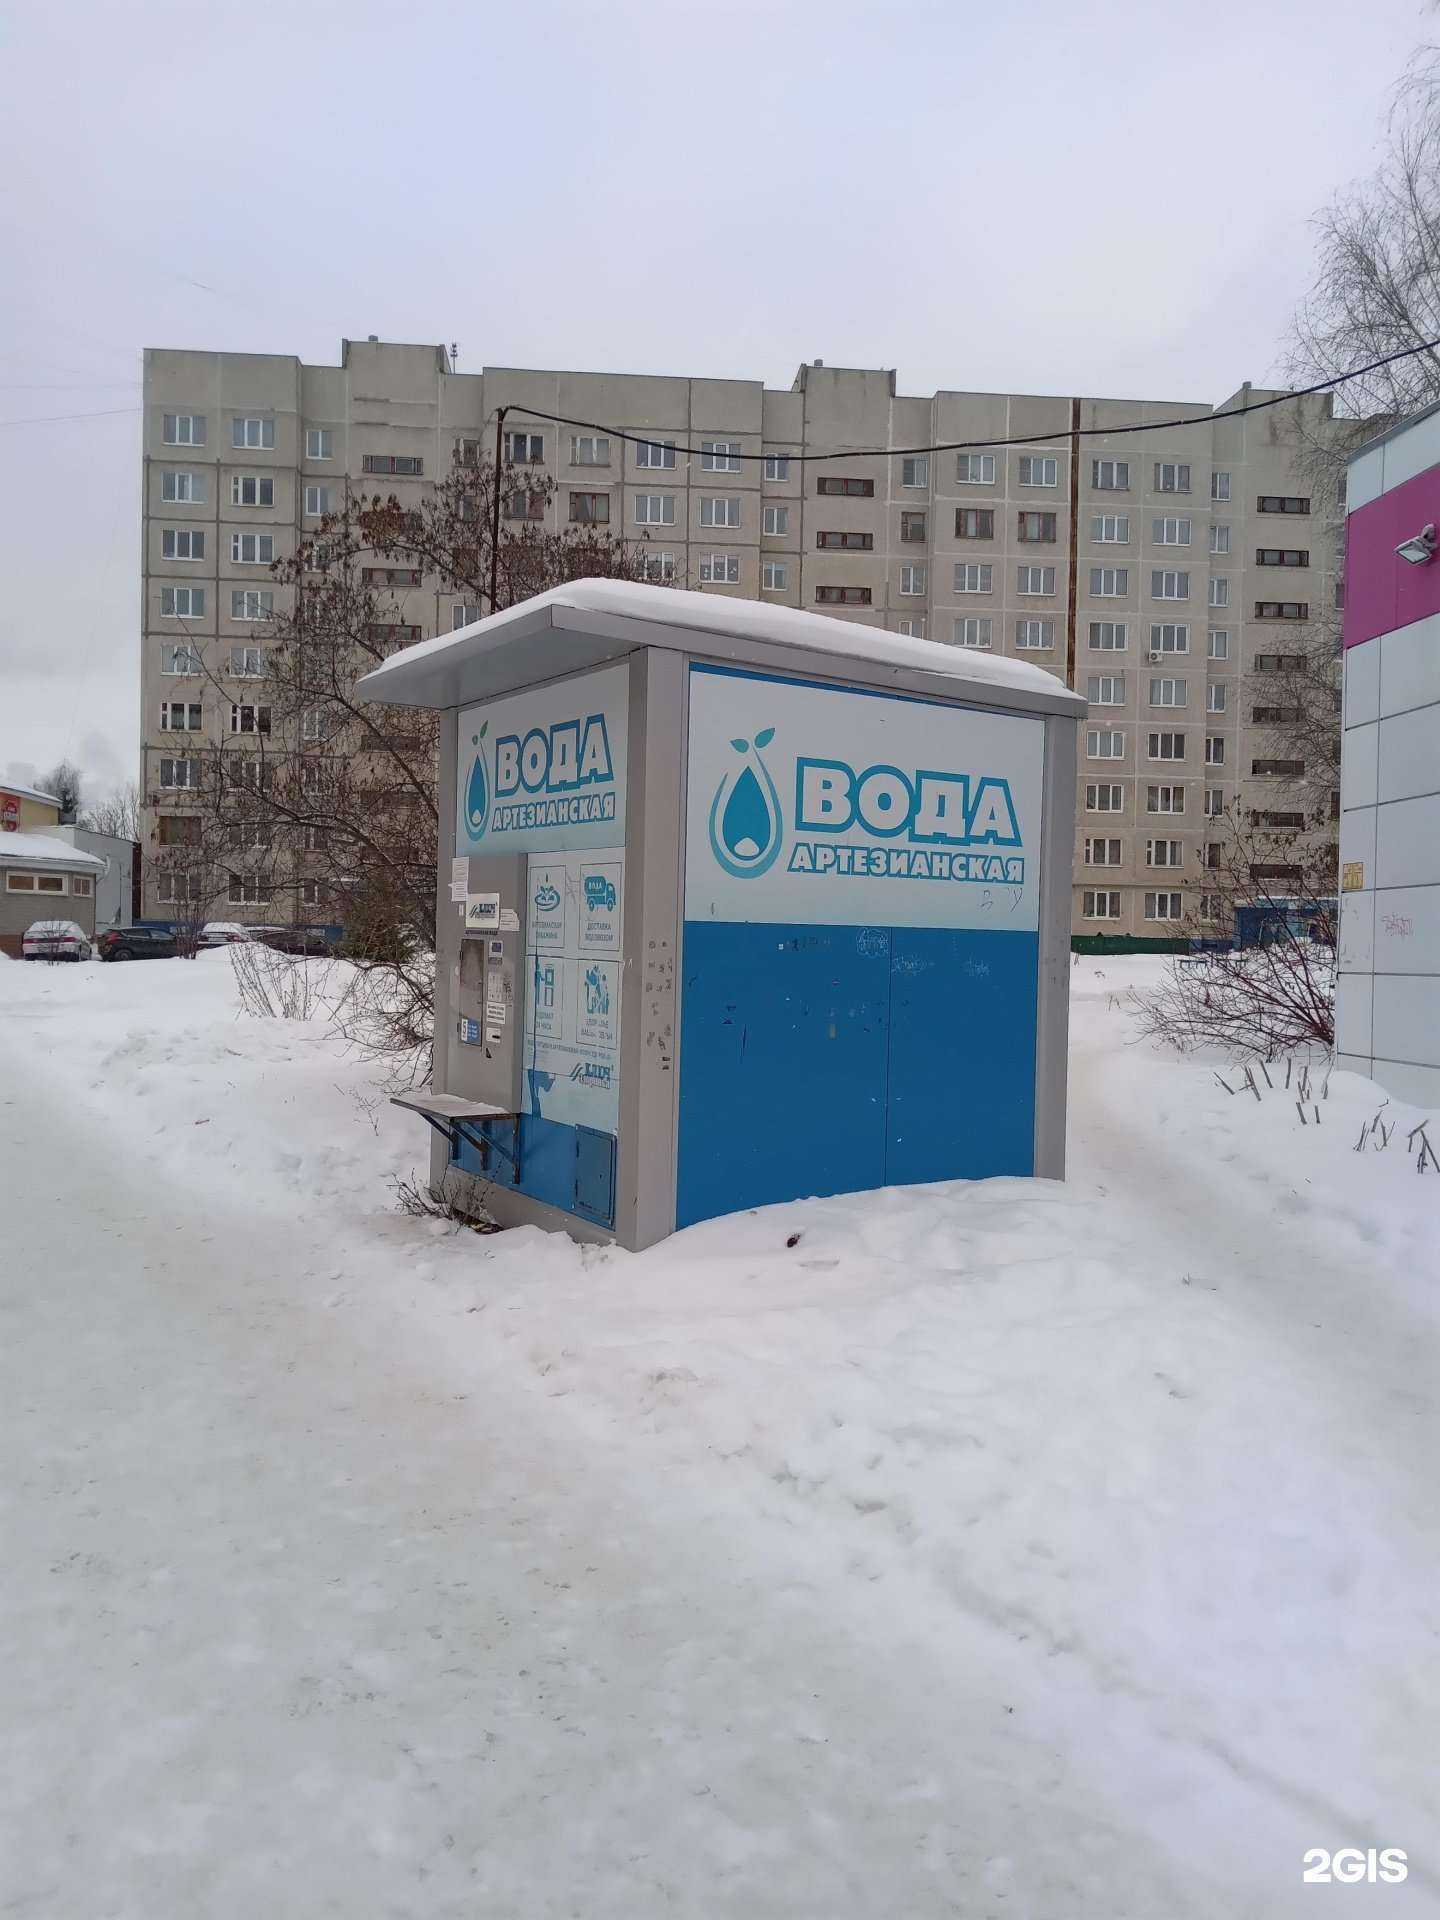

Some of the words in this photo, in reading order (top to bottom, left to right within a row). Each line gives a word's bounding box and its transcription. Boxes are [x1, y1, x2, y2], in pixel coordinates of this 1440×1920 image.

[495, 713, 614, 799] ВОДА
[491, 791, 616, 832] АРТЕЗИАНСКАЯ
[794, 756, 1023, 847] ВОДА
[787, 842, 1025, 884] АРТЕЗИАНСКАЯ
